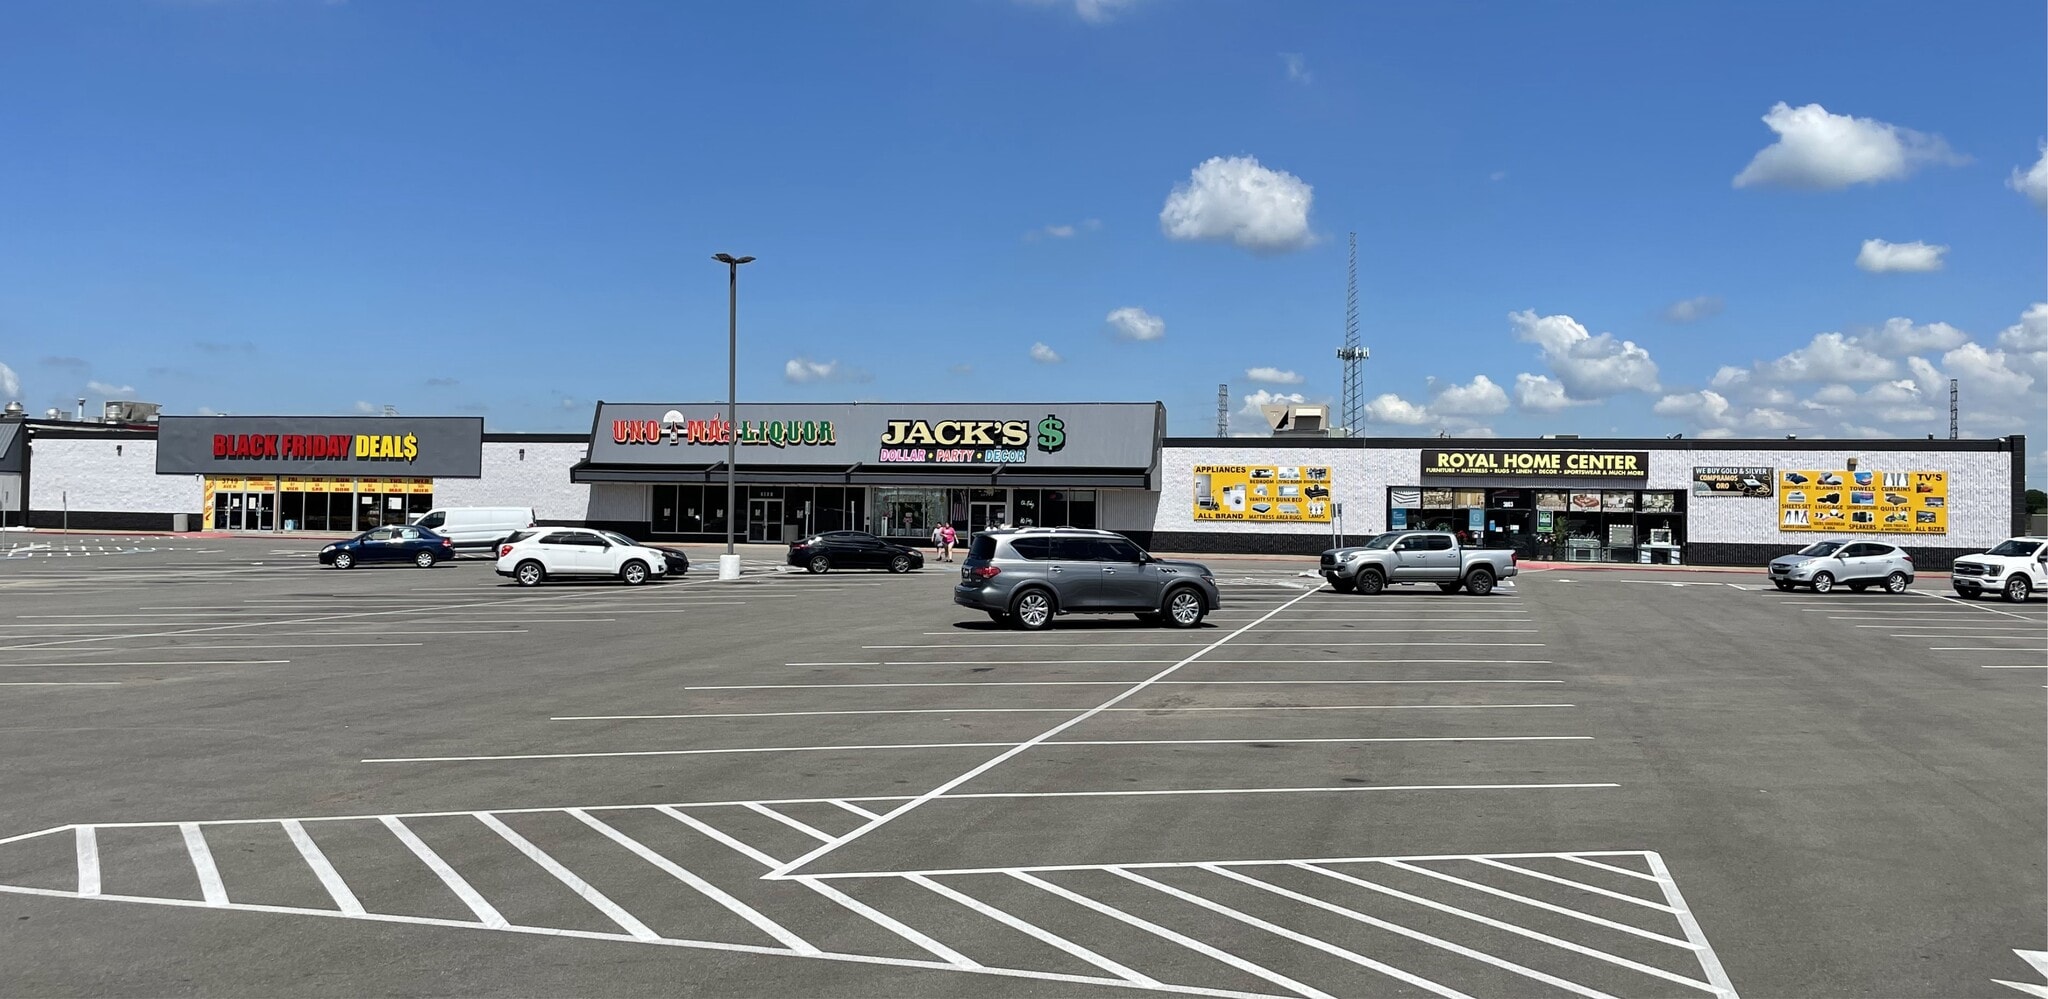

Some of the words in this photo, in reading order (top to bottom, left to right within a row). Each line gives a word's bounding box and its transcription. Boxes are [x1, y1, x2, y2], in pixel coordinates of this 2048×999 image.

[612, 420, 661, 444] UNO
[741, 420, 836, 447] LIQUOR
[881, 421, 1029, 446] JACK'S
[1038, 416, 1065, 451] $
[213, 434, 278, 459] BLACK
[281, 435, 352, 460] FRIDAY
[355, 432, 418, 462] DEAL$
[880, 449, 926, 463] DOLLAR
[935, 449, 975, 463] PARTY
[1438, 453, 1498, 468] ROYAL
[1504, 454, 1561, 469] HOME
[1567, 454, 1637, 470] CENTER
[1195, 466, 1247, 474] APPLIANCES
[1695, 467, 1707, 475] WE
[1699, 474, 1739, 482] COMPRAMOS
[1916, 473, 1943, 482] TV'S
